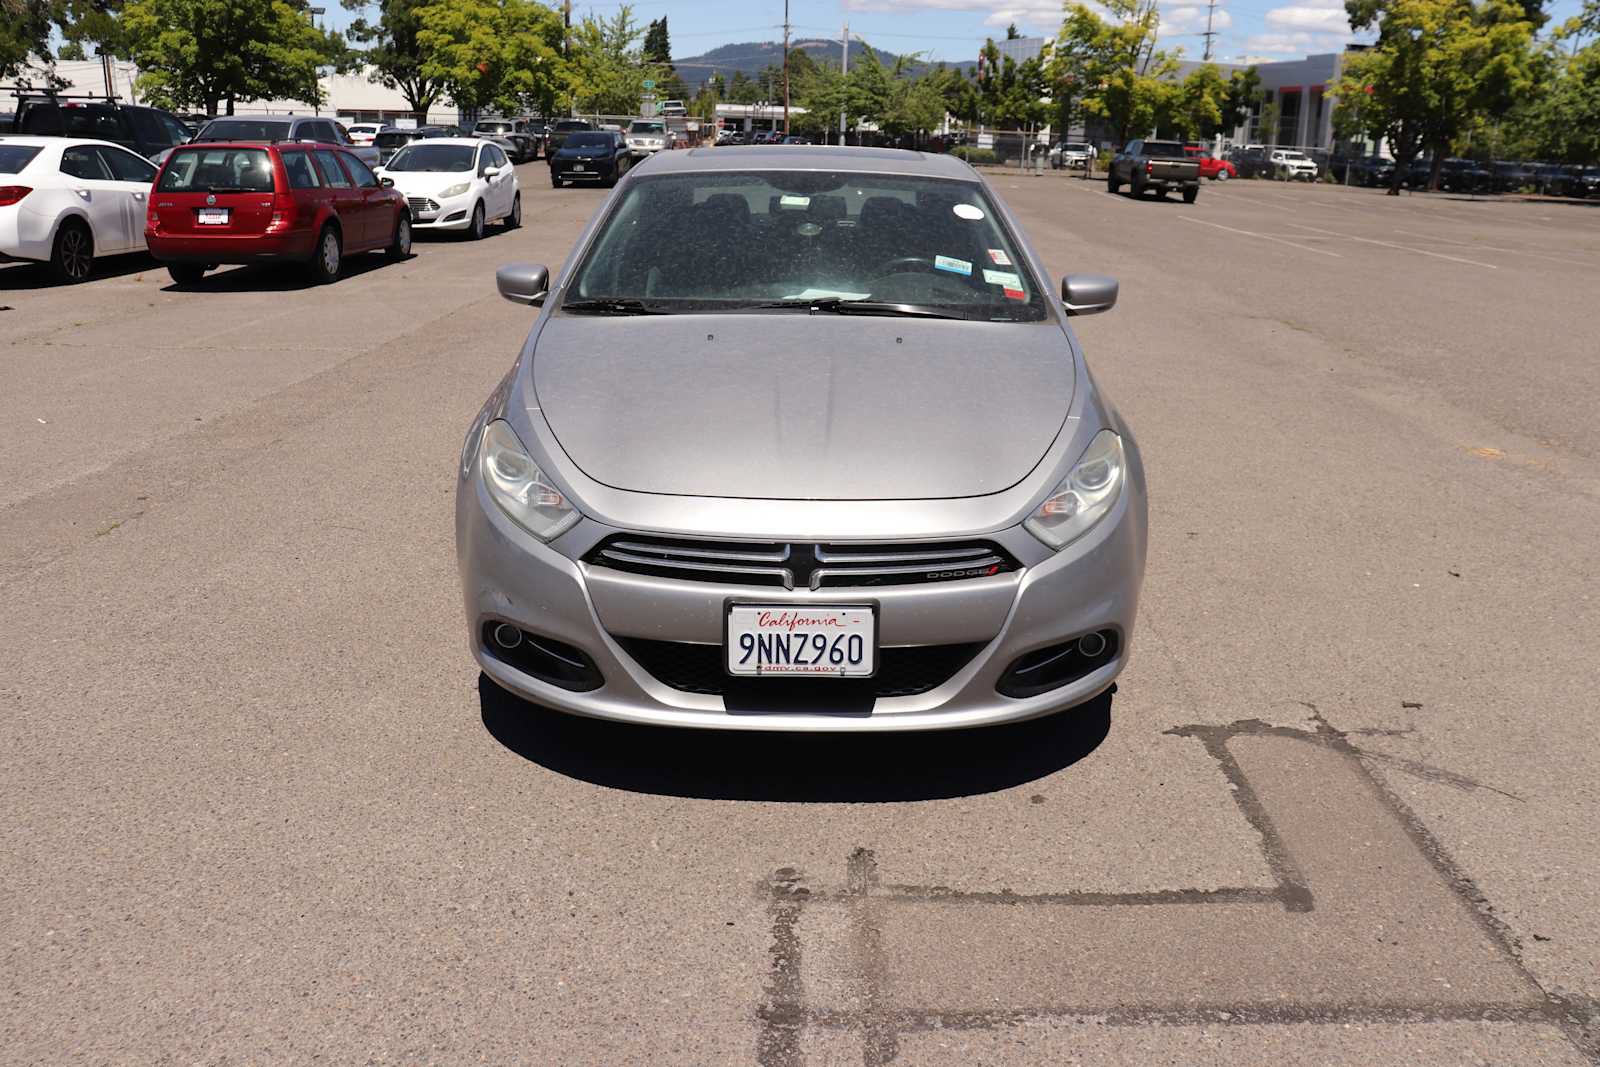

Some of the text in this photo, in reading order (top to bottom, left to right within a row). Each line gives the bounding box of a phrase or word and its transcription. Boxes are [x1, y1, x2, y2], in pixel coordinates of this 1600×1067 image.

[926, 568, 989, 578] DODGE
[759, 611, 846, 631] California
[739, 633, 863, 664] 9NNZ960
[764, 665, 837, 673] dmv.ca.gov
